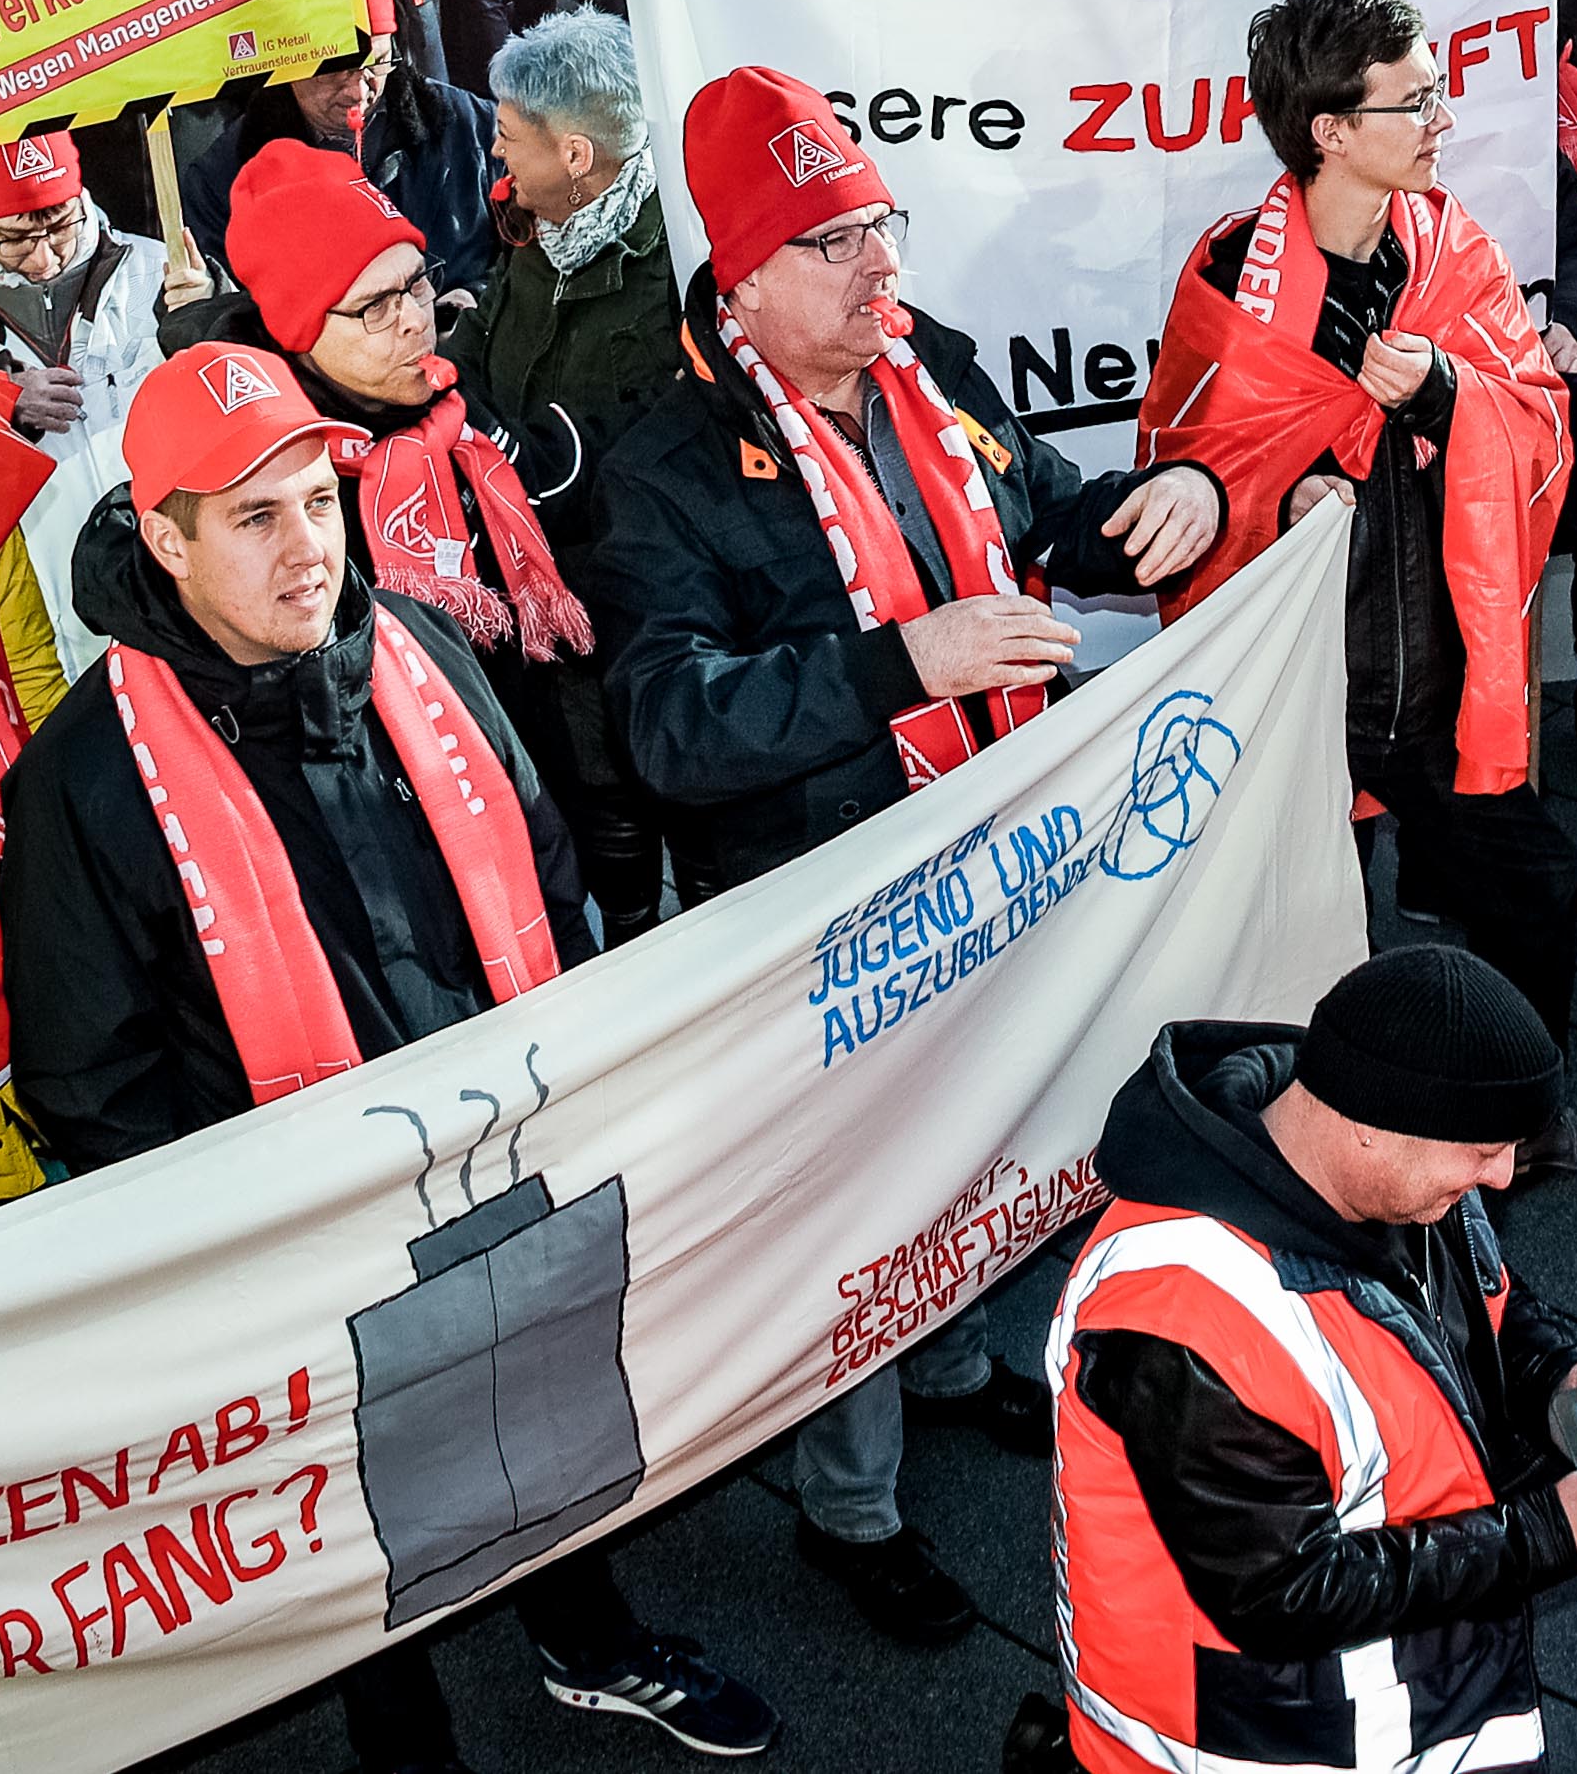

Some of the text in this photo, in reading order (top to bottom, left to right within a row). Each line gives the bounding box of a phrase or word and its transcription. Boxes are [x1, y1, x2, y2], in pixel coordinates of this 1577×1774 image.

[222, 51, 309, 79] Vertrauensleute
[262, 32, 312, 54] IG Metall
[824, 90, 1025, 151] sere
[809, 805, 1083, 1006] JUGEND UND
[814, 812, 998, 953] ELEVATOR
[823, 839, 1104, 1069] AUSZUBILDENDE
[50, 1463, 330, 1668] FANG?
